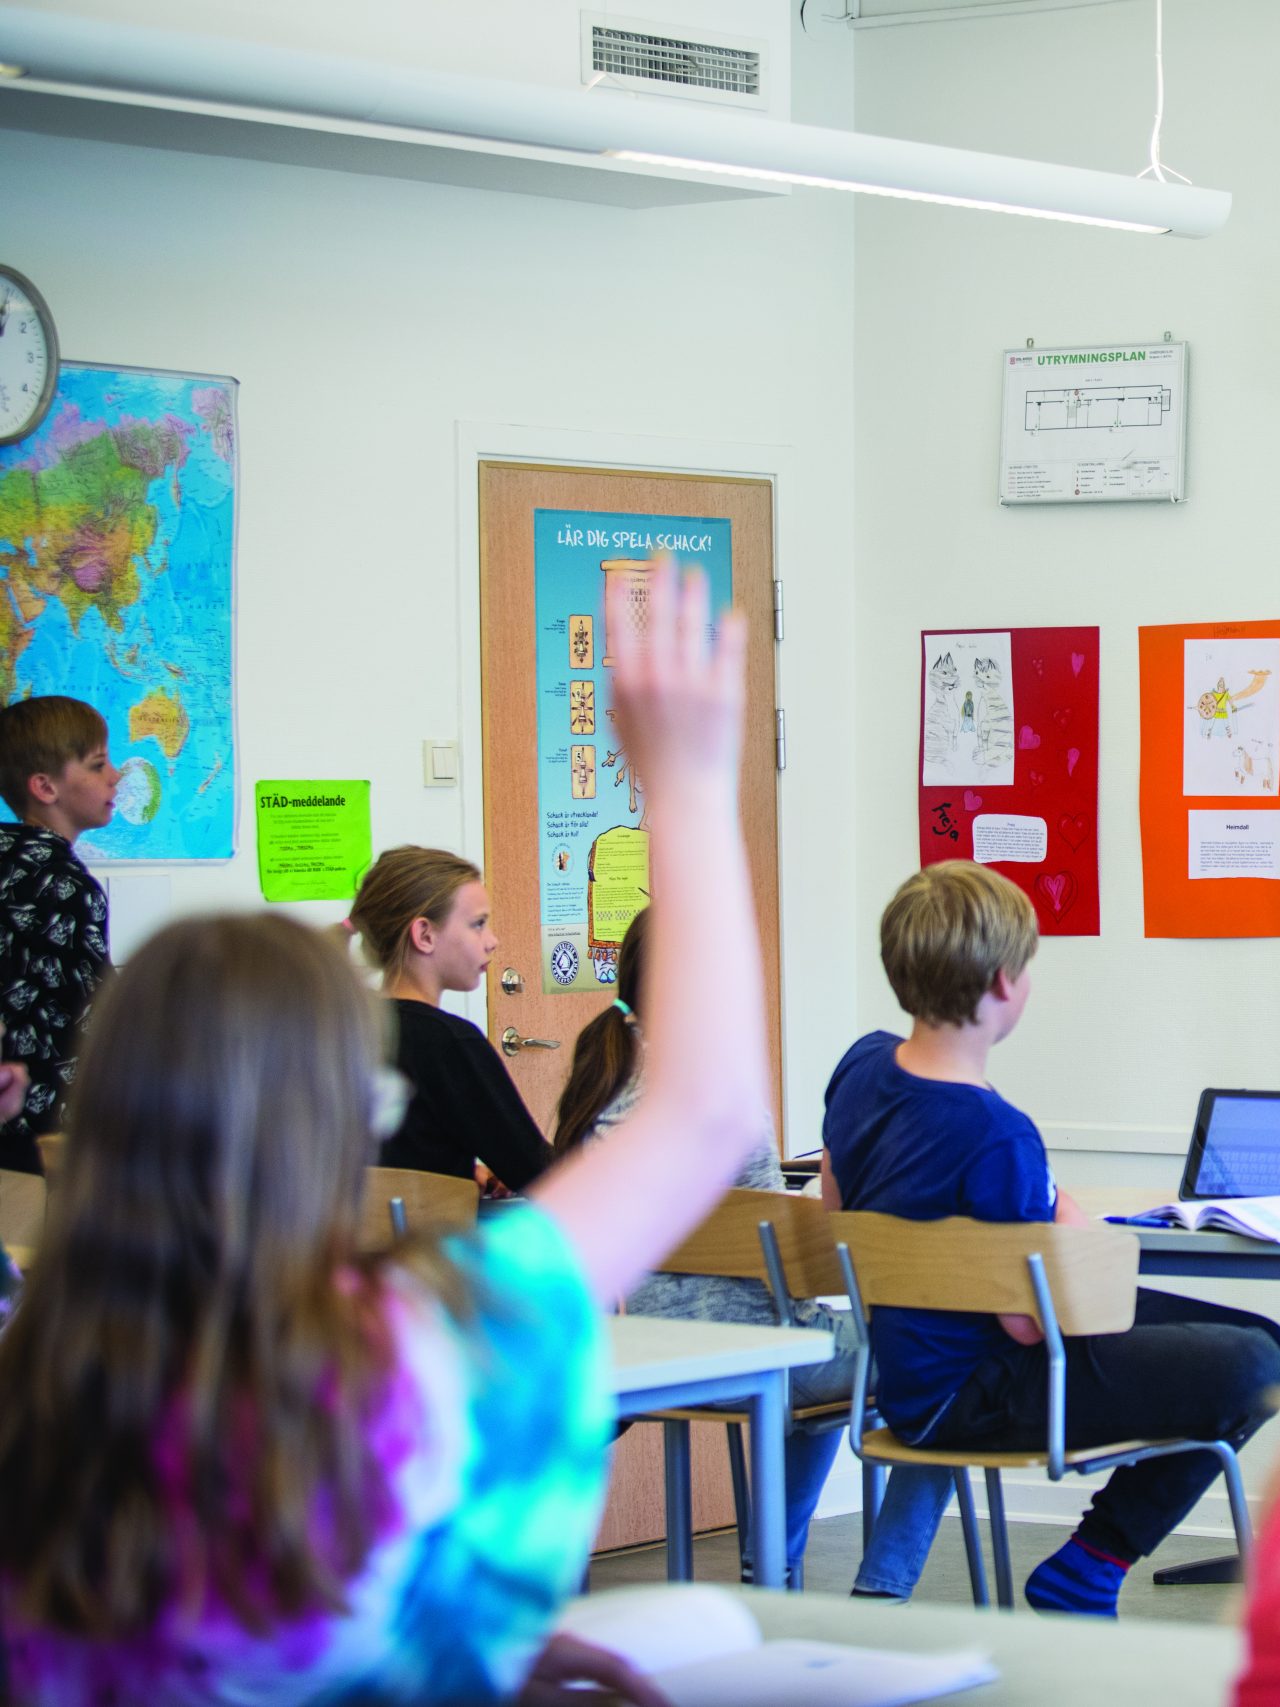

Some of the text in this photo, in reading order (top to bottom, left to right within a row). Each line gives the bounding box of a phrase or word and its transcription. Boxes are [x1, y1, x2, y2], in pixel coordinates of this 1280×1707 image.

[19, 322, 27, 334] 2
[27, 352, 34, 363] 3
[1037, 351, 1146, 366] UTRYMNINGSPLAN
[21, 384, 29, 392] 4
[557, 523, 712, 552] LÄR DIG SPELA SCHACK!
[260, 793, 346, 808] STÄD-meddelande
